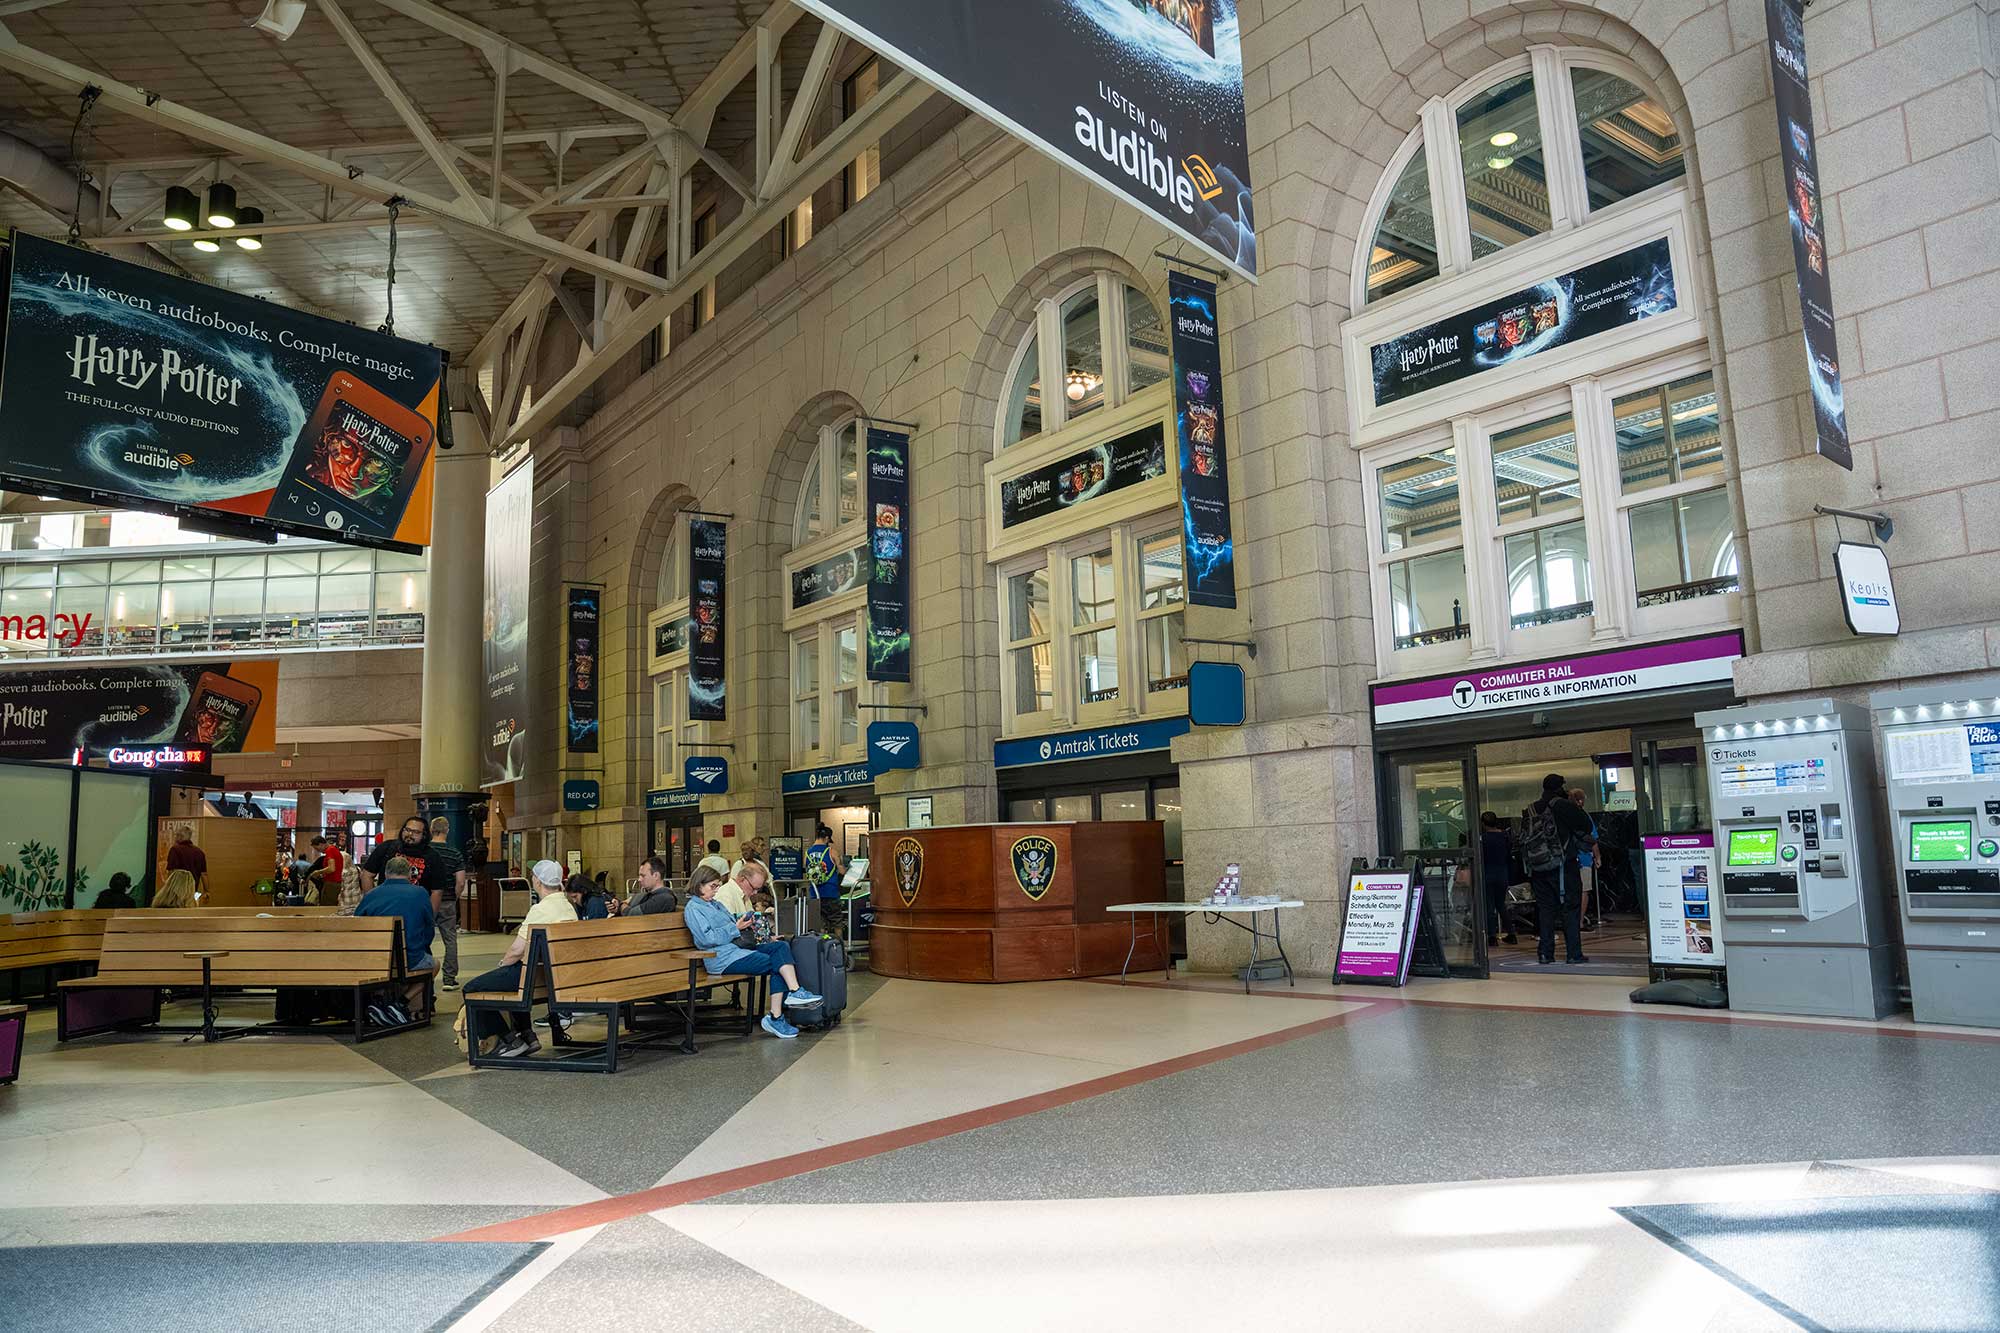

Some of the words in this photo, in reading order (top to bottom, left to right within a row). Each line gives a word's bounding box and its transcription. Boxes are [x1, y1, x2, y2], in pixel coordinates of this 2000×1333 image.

[1099, 80, 1146, 128] LISTEN
[1150, 118, 1168, 143] ON
[1075, 105, 1195, 214] audible
[1581, 297, 1613, 312] Complete
[55, 271, 90, 295] All
[97, 286, 153, 312] seven
[158, 303, 273, 343] audiobooks.
[278, 330, 361, 365] Complete
[364, 356, 415, 381] magic.
[1178, 316, 1196, 332] Harry
[1195, 319, 1214, 336] Potter
[1400, 345, 1428, 372] Harry
[1427, 335, 1459, 365] Potter
[66, 333, 158, 390] Harry
[160, 348, 243, 407] Potter
[65, 390, 91, 406] THE
[93, 396, 153, 418] FULL-CAST
[154, 410, 189, 425] AUDIO
[190, 417, 240, 436] EDITIONS
[342, 412, 372, 438] Harry
[369, 425, 400, 455] Potter
[123, 450, 179, 471] audible
[873, 462, 888, 475] Harry
[888, 463, 904, 477] Potter
[1017, 485, 1034, 505] Harry
[1033, 480, 1051, 499] Potter
[1197, 536, 1220, 547] audible
[1849, 580, 1888, 597] Keolis
[0, 612, 93, 647] macy
[0, 684, 28, 694] seven
[31, 678, 97, 693] audiobooks.
[99, 676, 152, 693] Complete
[155, 677, 190, 691] magic.
[1480, 667, 1546, 689] COMMUTER
[1548, 665, 1575, 680] RAIL
[1456, 687, 1472, 704] T
[1482, 686, 1541, 705] TICKETING
[1542, 686, 1552, 697] &
[1553, 673, 1637, 695] INFORMATION
[3, 702, 48, 737] Potter
[99, 711, 138, 723] audible
[1968, 725, 1989, 740] Tap
[1970, 733, 1999, 744] Ride
[1054, 735, 1096, 756] Amtrak
[1098, 731, 1140, 750] Tickets
[108, 747, 156, 768] Gong
[156, 747, 185, 763] cha
[1723, 748, 1757, 760] Tickets
[817, 771, 843, 785] Amtrak
[843, 769, 868, 783] Tickets
[653, 795, 669, 806] Amtrak
[1613, 798, 1631, 806] OPEN
[897, 841, 920, 857] POLICE
[1016, 840, 1052, 855] POLICE
[1351, 893, 1398, 901] Spring/Summer
[1378, 902, 1402, 910] Change
[1348, 912, 1375, 920] Effective
[1347, 921, 1372, 929] Monday,
[1372, 921, 1386, 929] May
